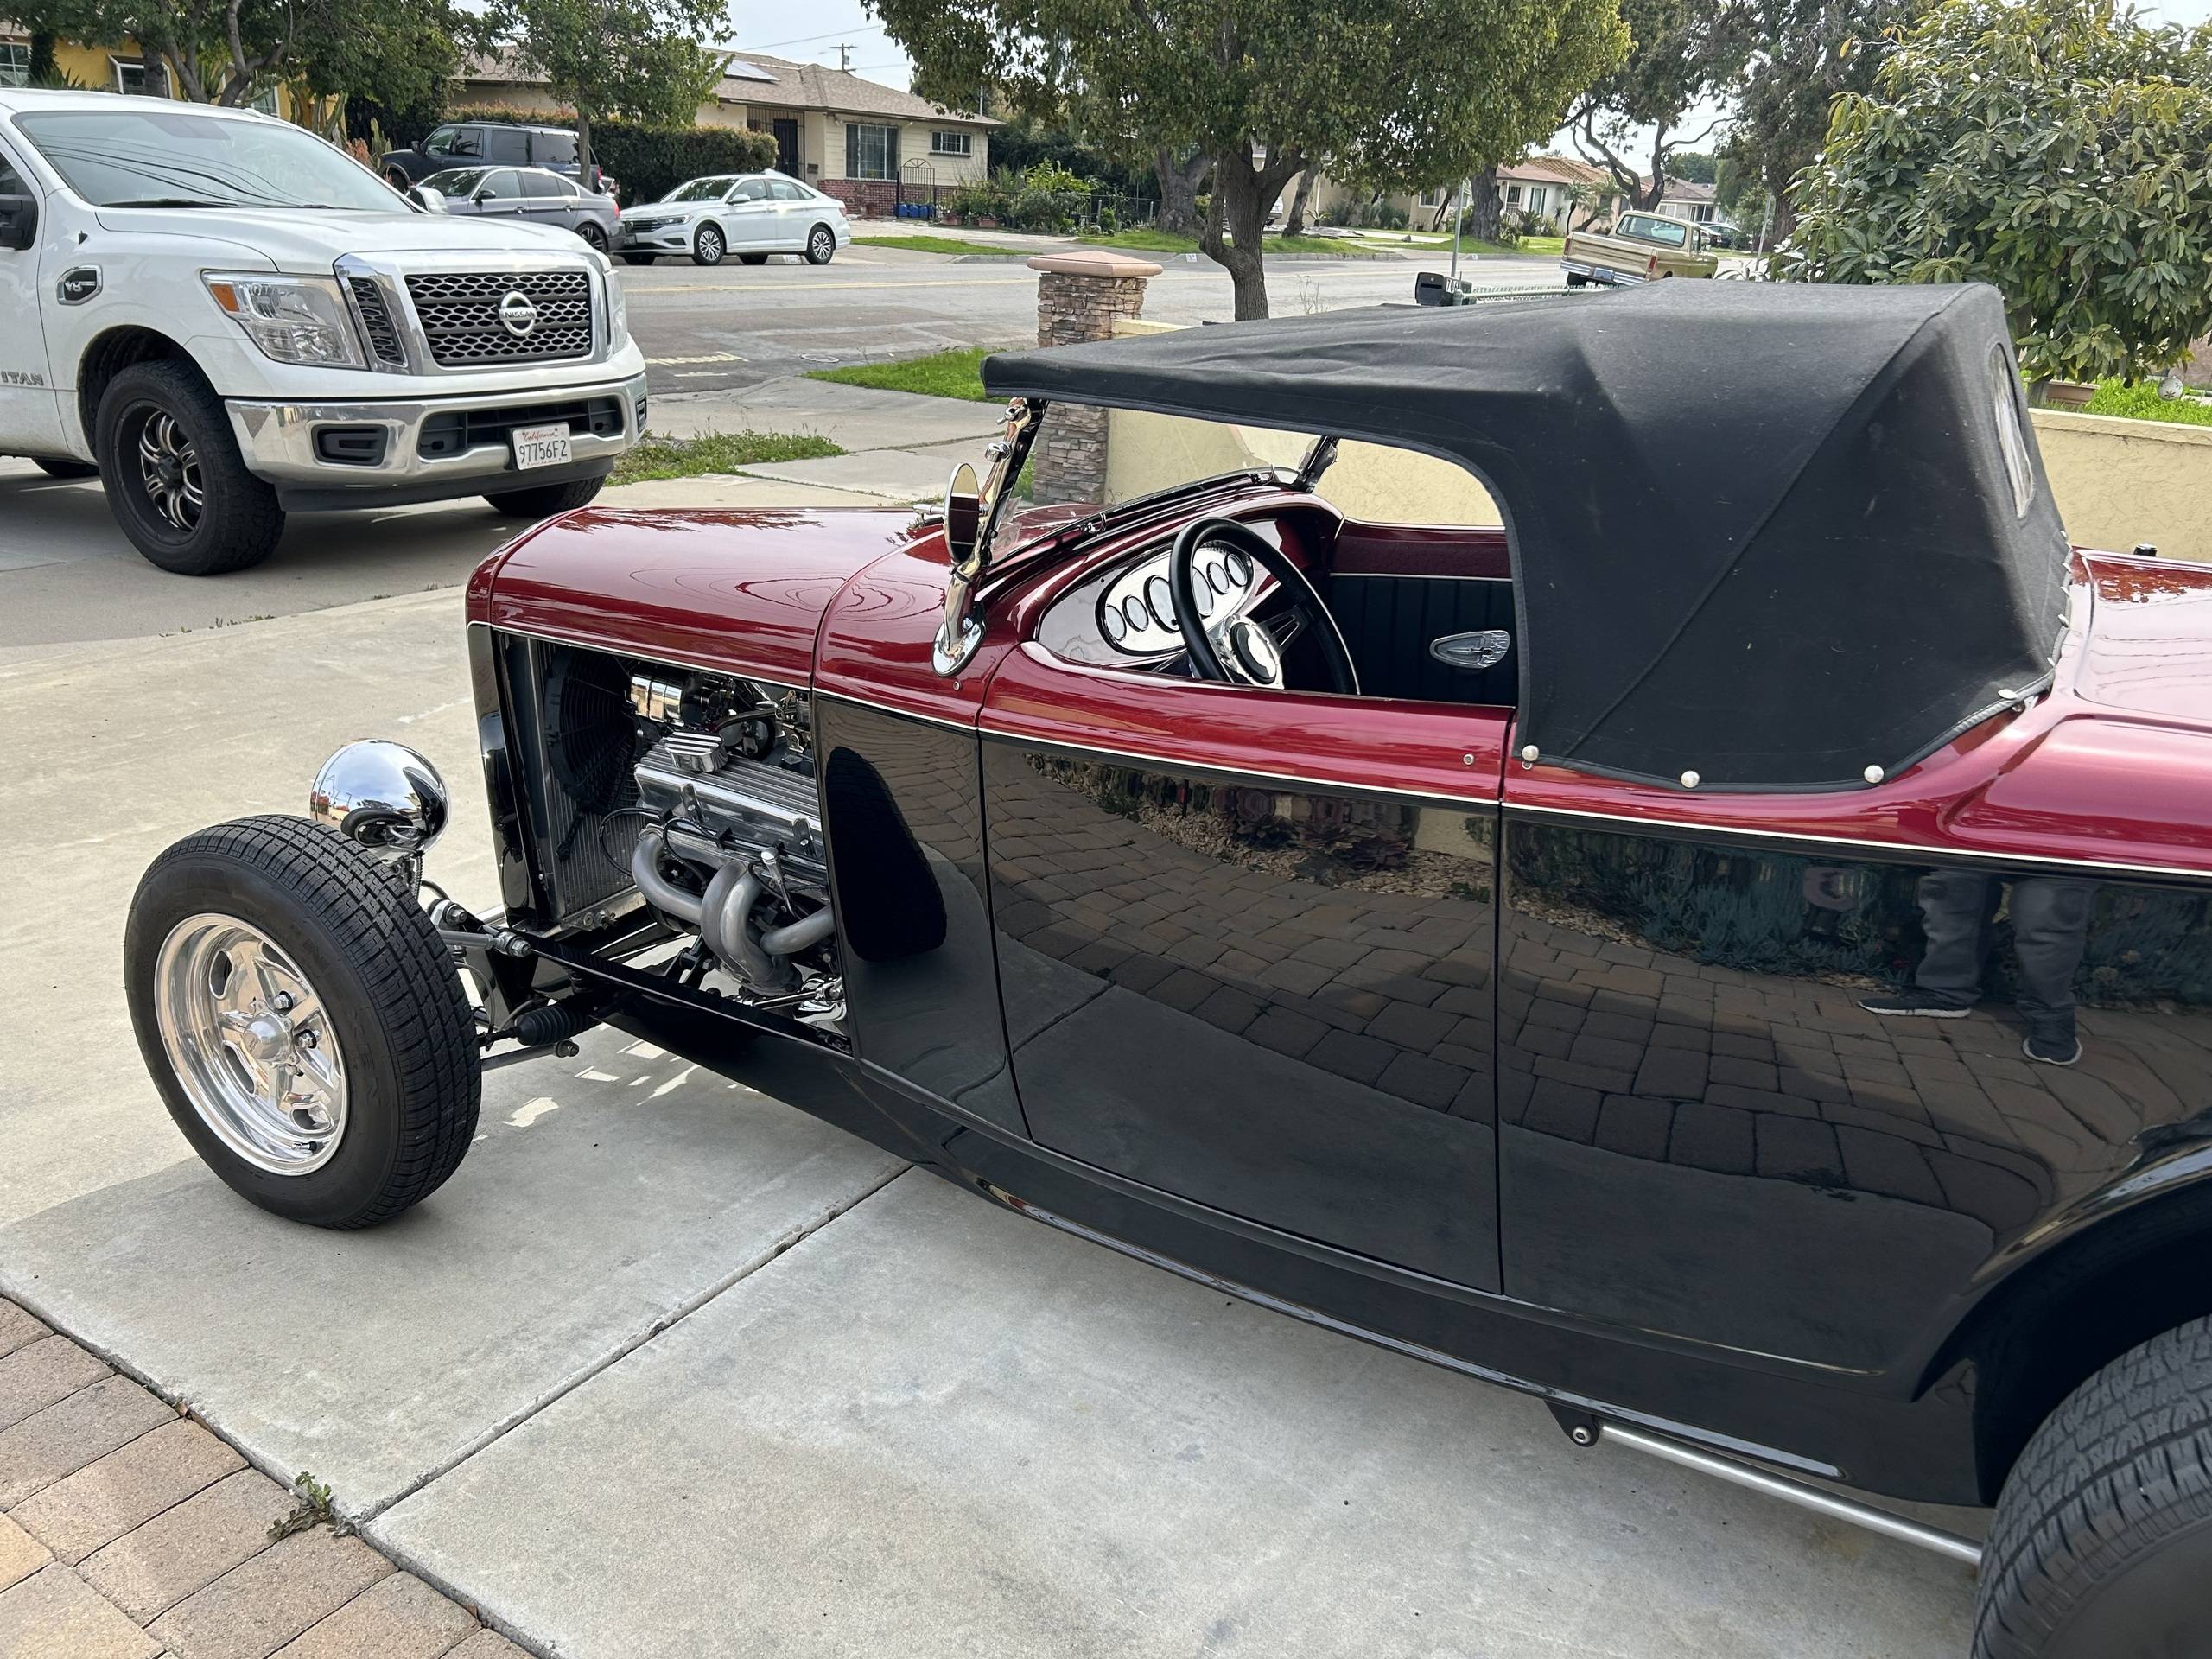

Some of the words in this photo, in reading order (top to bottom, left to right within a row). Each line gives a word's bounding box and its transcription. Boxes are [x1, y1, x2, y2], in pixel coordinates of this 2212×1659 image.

[65, 281, 83, 292] V8
[0, 371, 44, 386] ITAN
[518, 439, 568, 464] 97756F2
